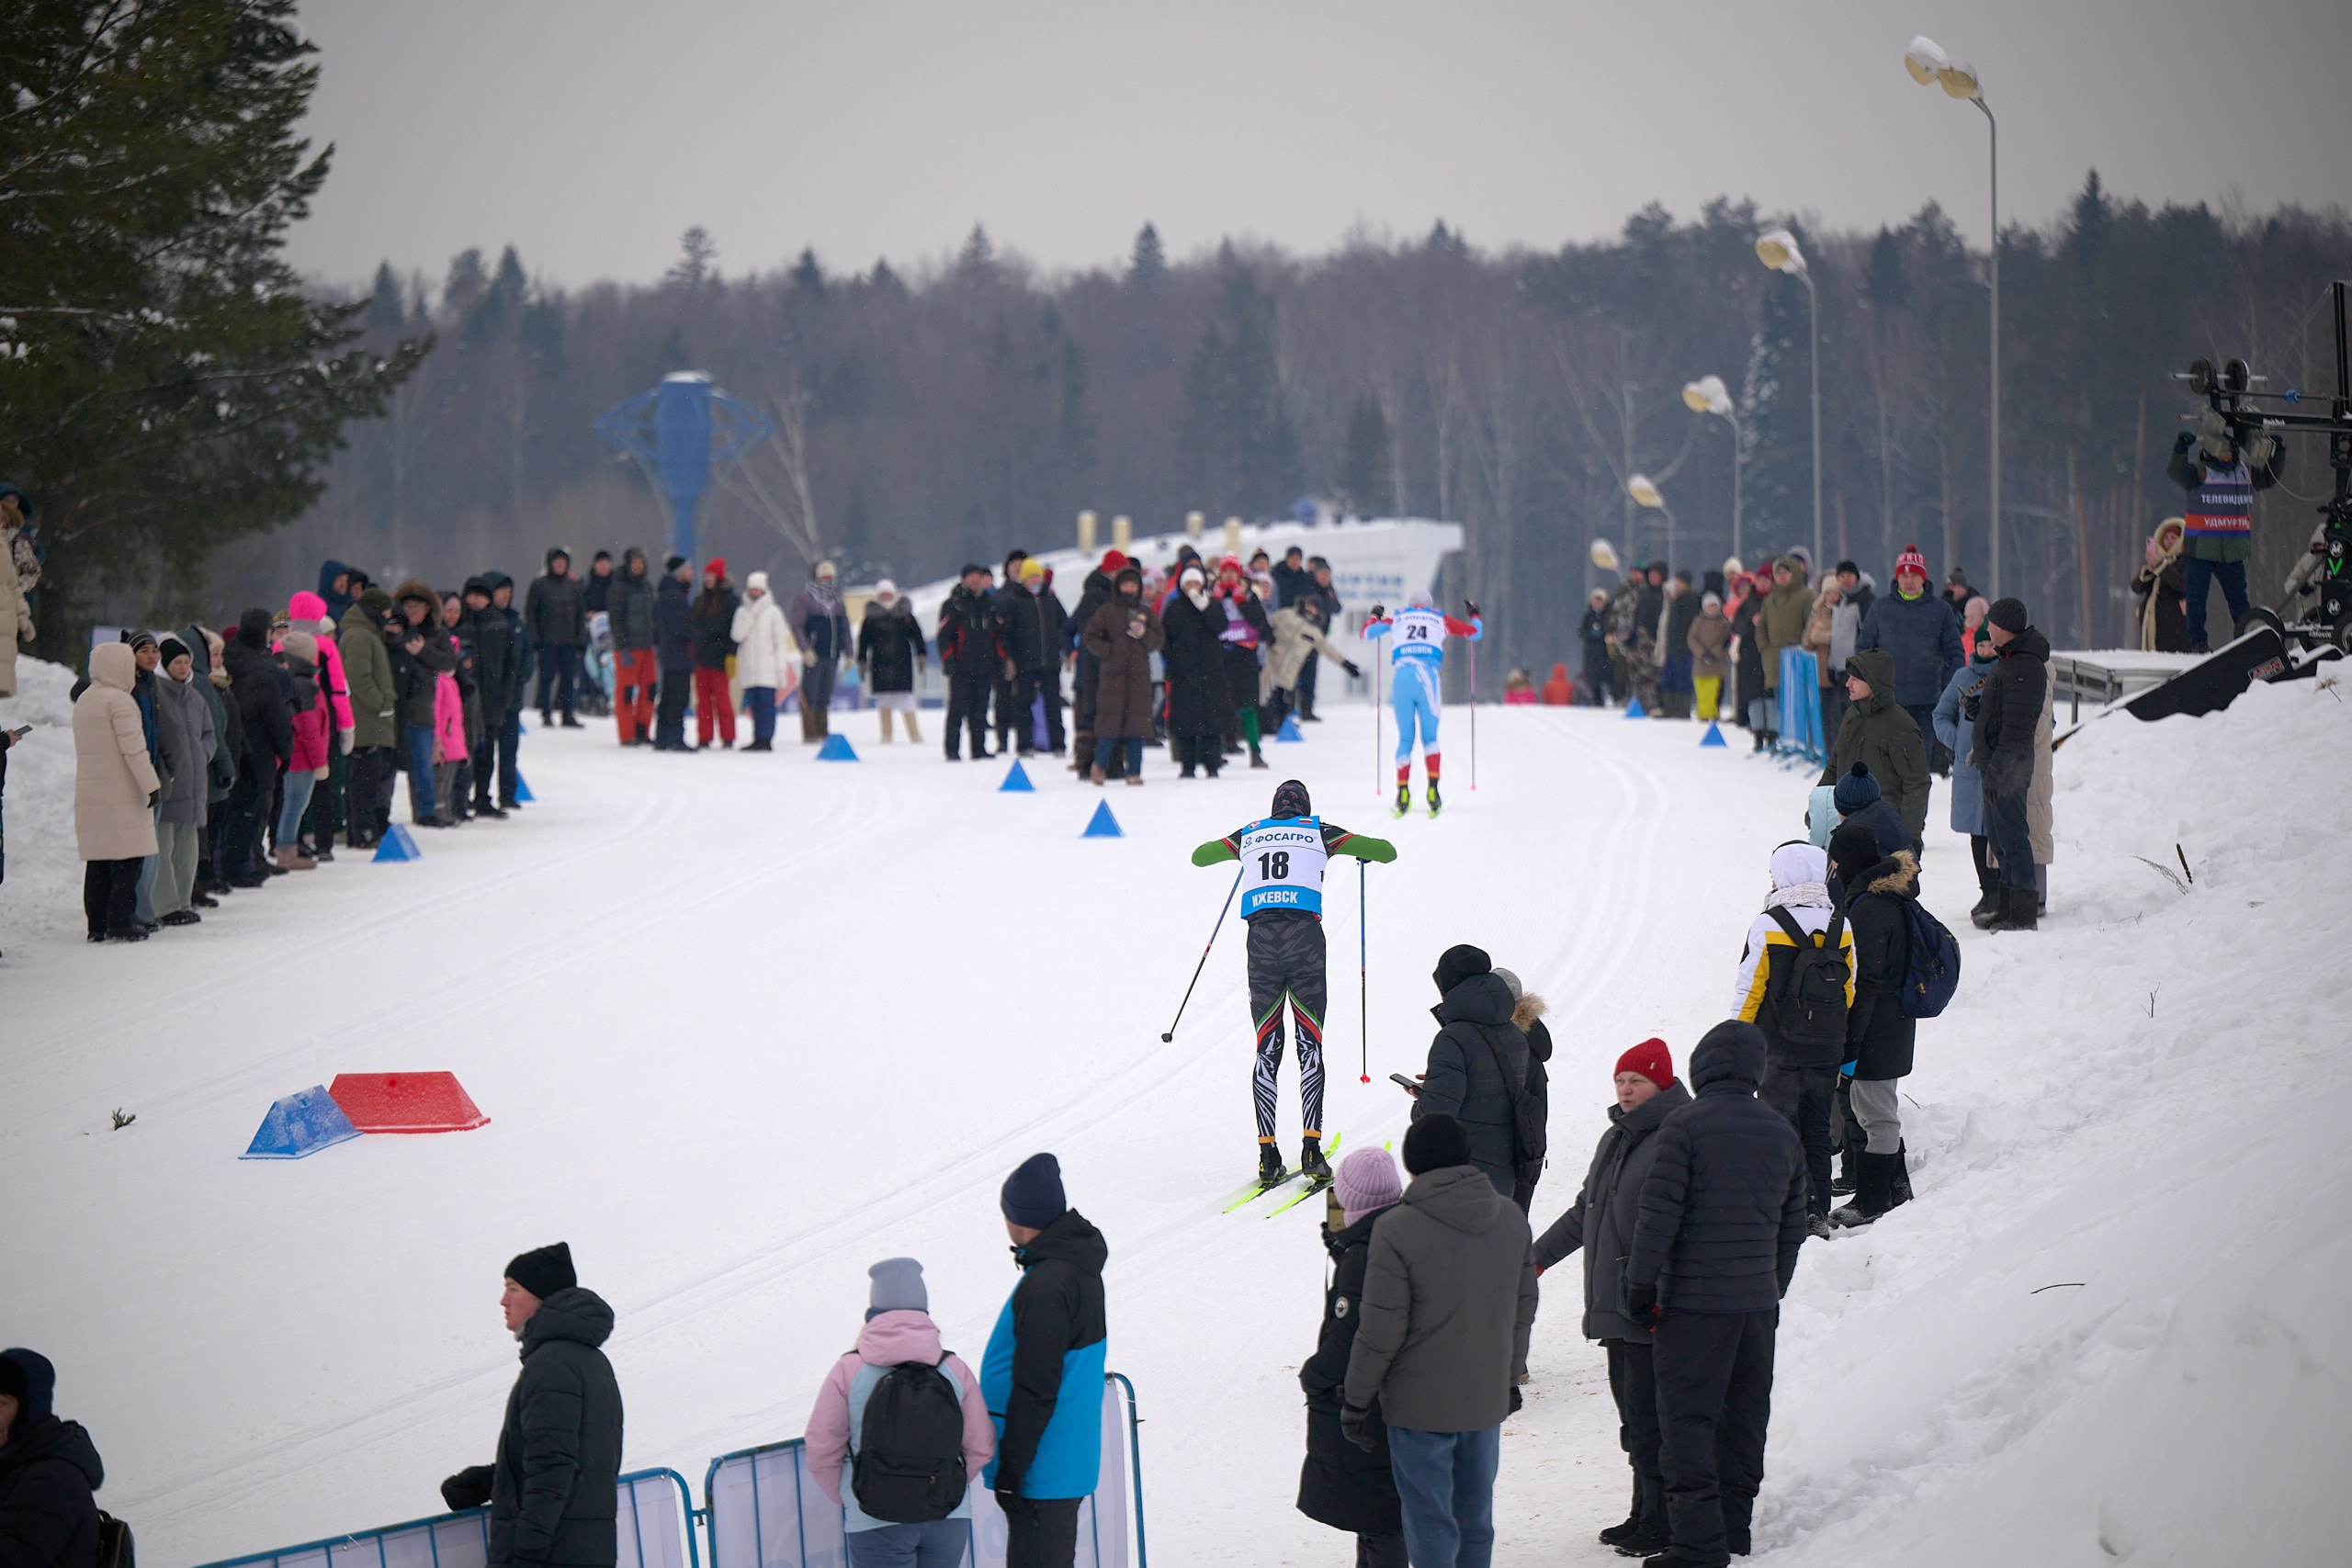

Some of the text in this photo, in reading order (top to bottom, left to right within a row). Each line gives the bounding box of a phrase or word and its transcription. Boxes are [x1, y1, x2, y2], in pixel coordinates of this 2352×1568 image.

[2200, 494, 2254, 505] ТЕЛЕВИДЕНИ
[2203, 517, 2247, 528] УДМУРТИ
[1407, 625, 1428, 640] 24
[1400, 646, 1433, 655] ИЖЕВСК
[1255, 833, 1314, 843] ФОСАГРО
[1258, 852, 1289, 880] 18
[1320, 870, 1325, 883] 1
[1252, 891, 1297, 908] ИЖЕВСК
